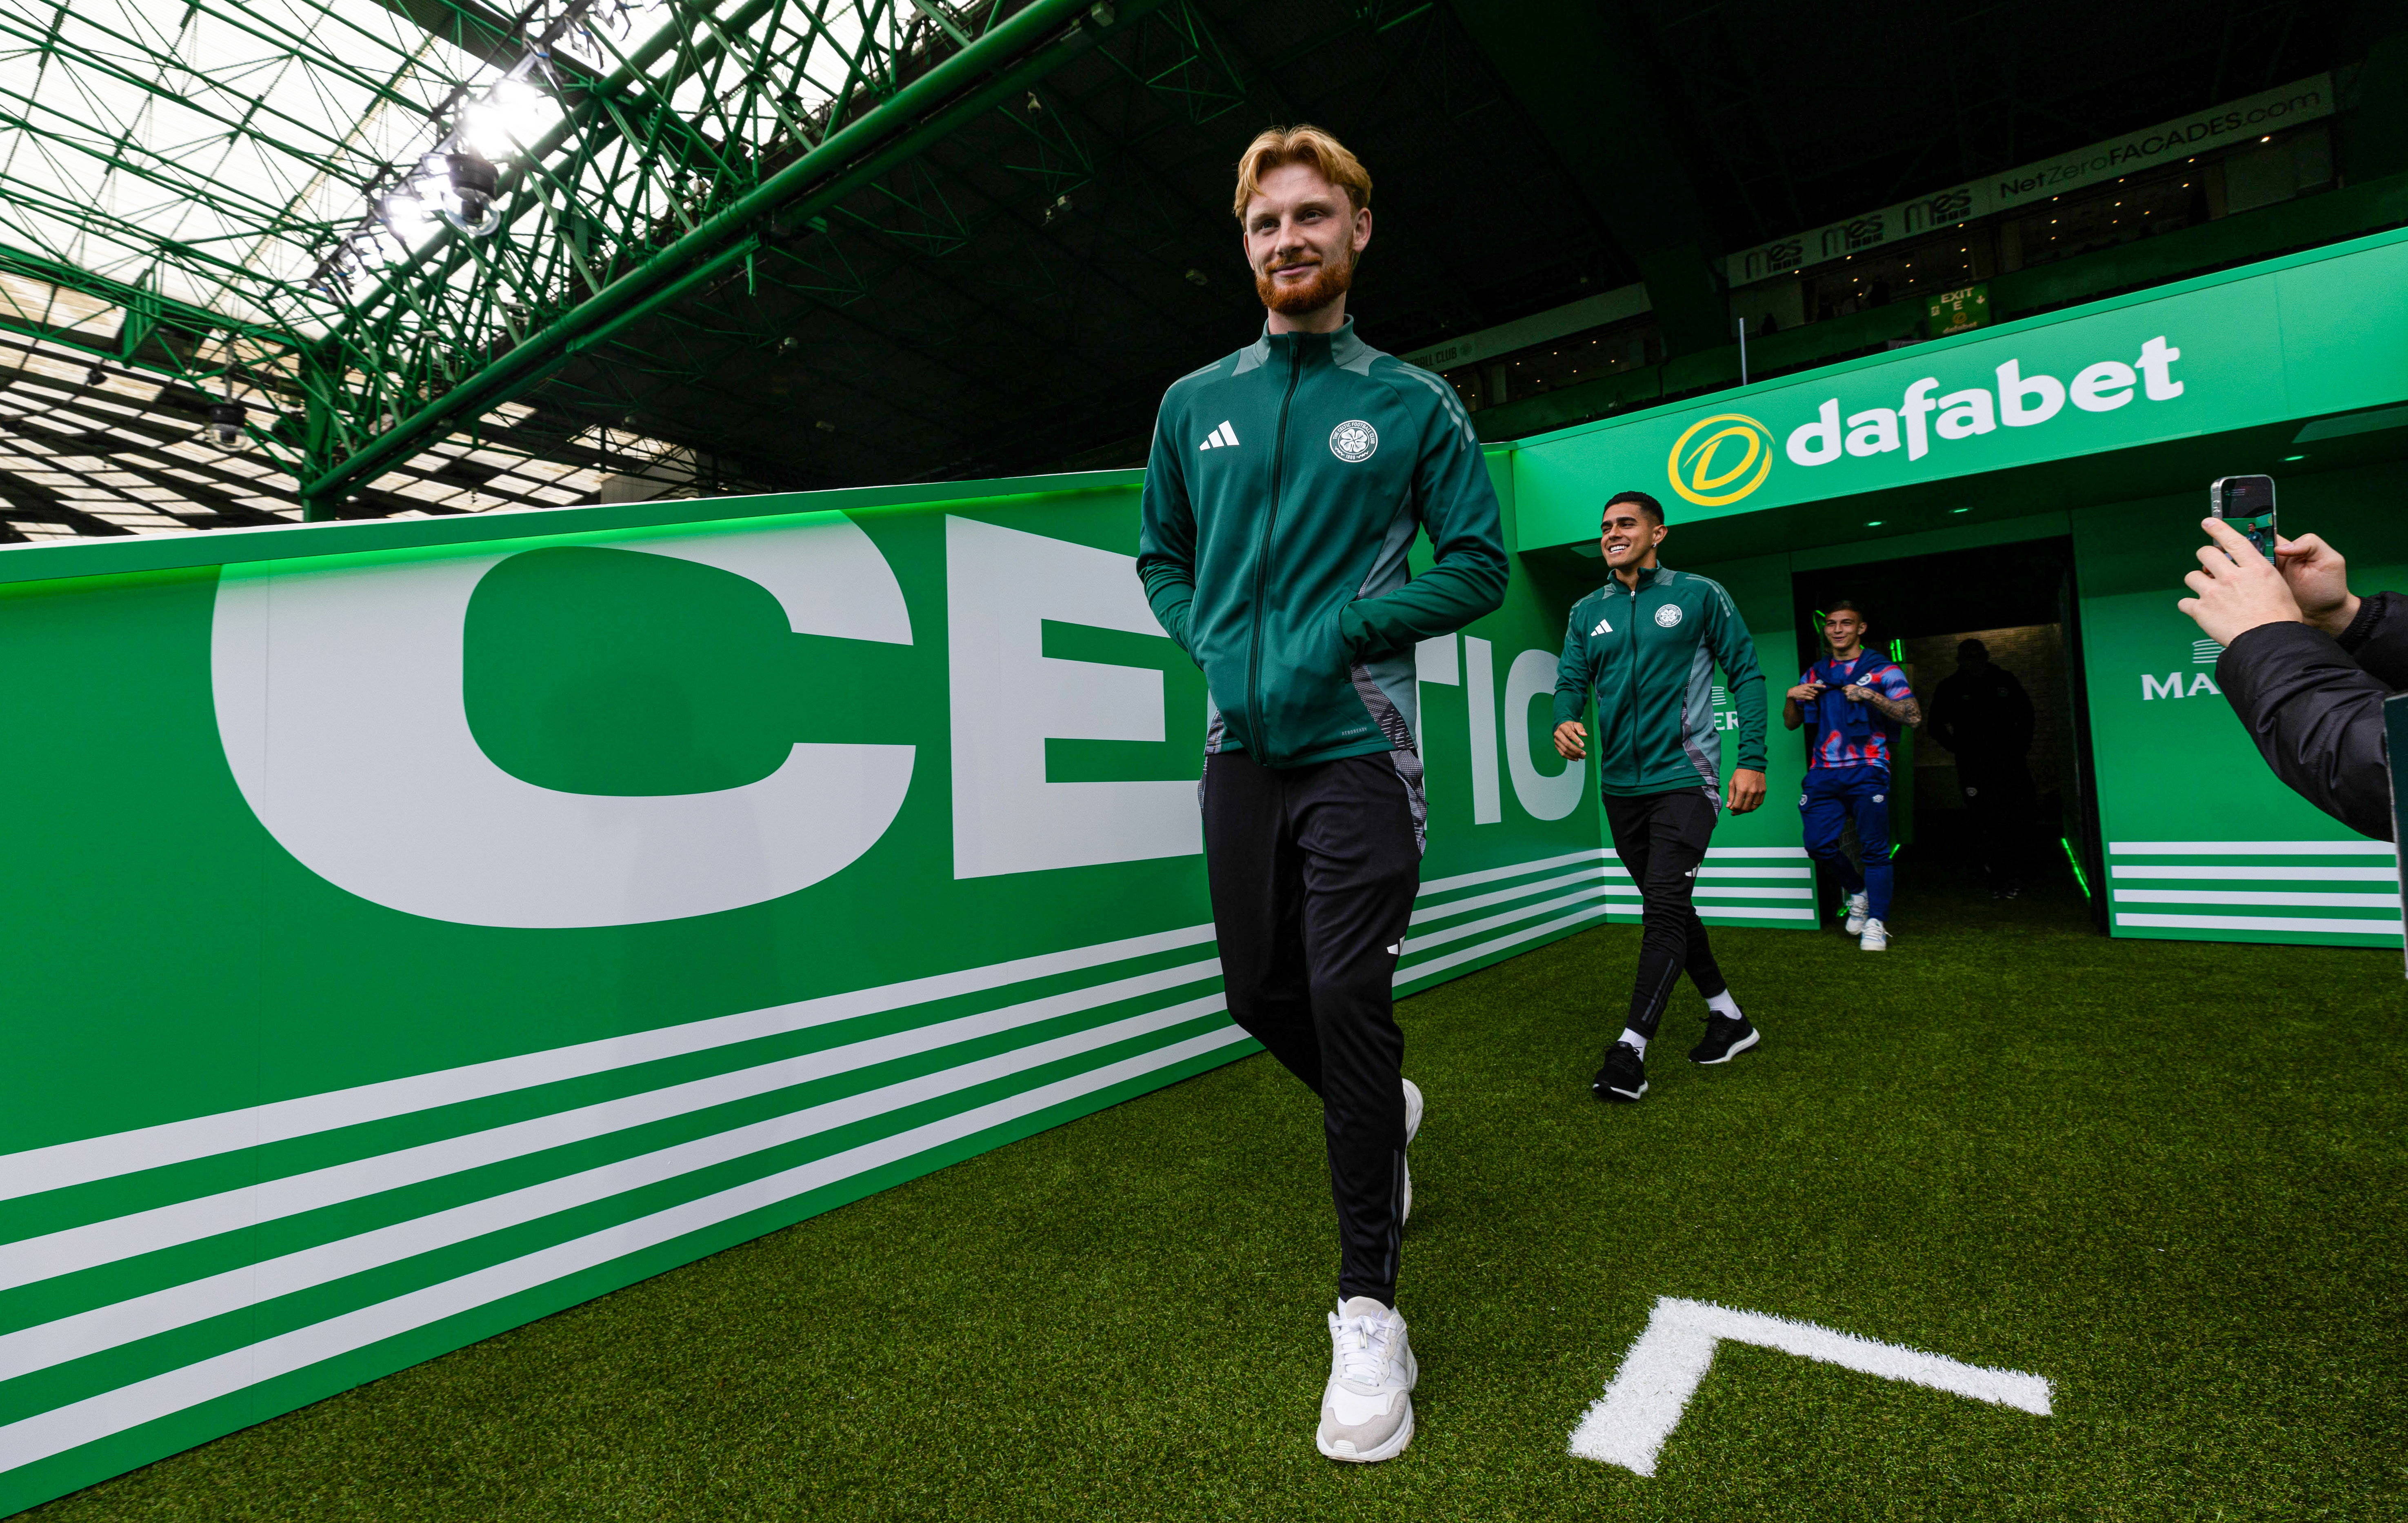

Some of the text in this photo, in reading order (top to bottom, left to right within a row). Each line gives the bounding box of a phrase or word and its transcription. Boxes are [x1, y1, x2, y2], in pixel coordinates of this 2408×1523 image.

[2001, 91, 2321, 199] NetZeroFACADES.com
[1942, 287, 1974, 303] EXIT
[1953, 300, 1963, 310] E
[1436, 347, 1457, 364] CLUB
[1786, 336, 2184, 467] dafabet
[1337, 422, 1351, 431] CELTIC
[1351, 422, 1372, 434] FOOTBALL
[2140, 671, 2222, 700] MA
[210, 509, 1586, 929] CEIC
[1714, 711, 1739, 731] ER
